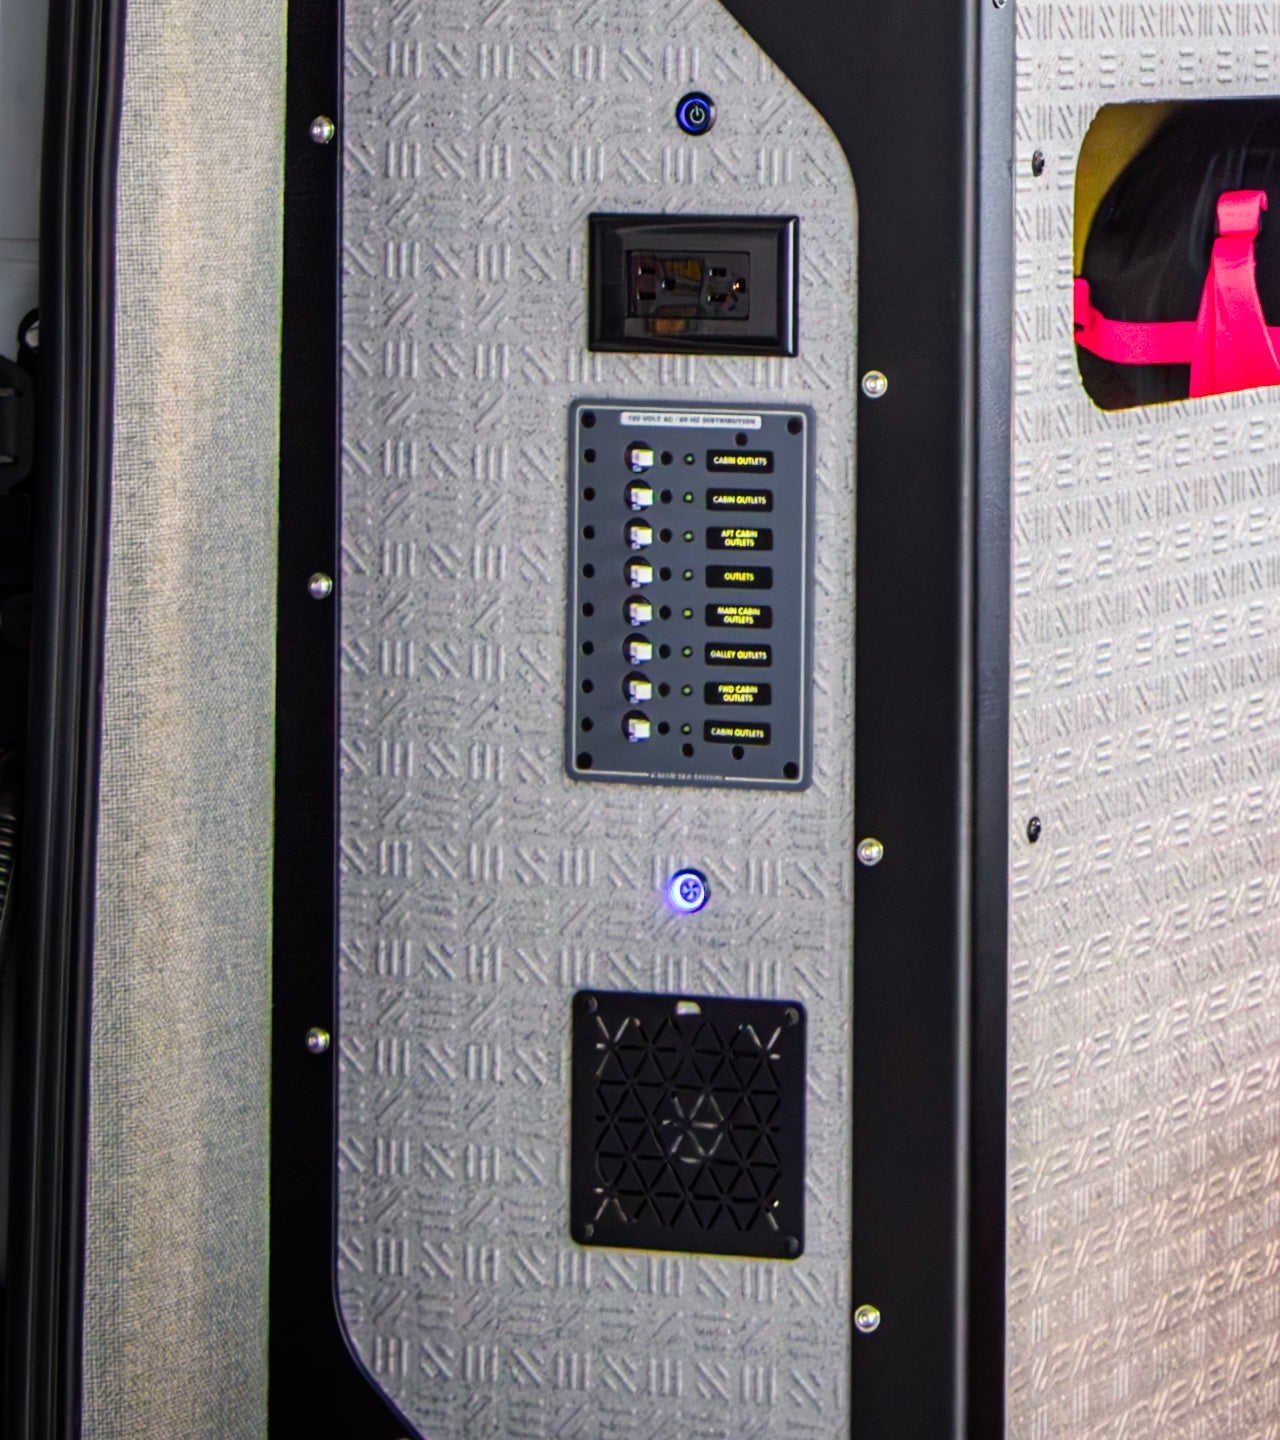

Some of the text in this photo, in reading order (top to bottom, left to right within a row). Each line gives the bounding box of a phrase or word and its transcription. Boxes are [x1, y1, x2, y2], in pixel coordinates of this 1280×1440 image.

[713, 456, 767, 466] CABIN OUTLETS
[713, 495, 767, 505] CABIN OUTLETS
[721, 529, 758, 539] AFT CABIN
[724, 538, 755, 547] OUTLETS
[724, 572, 755, 582] OUTLETS
[717, 606, 760, 617] MAIN CABIN
[723, 615, 754, 625] OUTLETS
[710, 649, 768, 660] GALLEY OUTLETS
[718, 684, 759, 694] FWD CABIN
[722, 693, 754, 703] OUTLETS
[711, 727, 765, 738] CABIN OUTLETS
